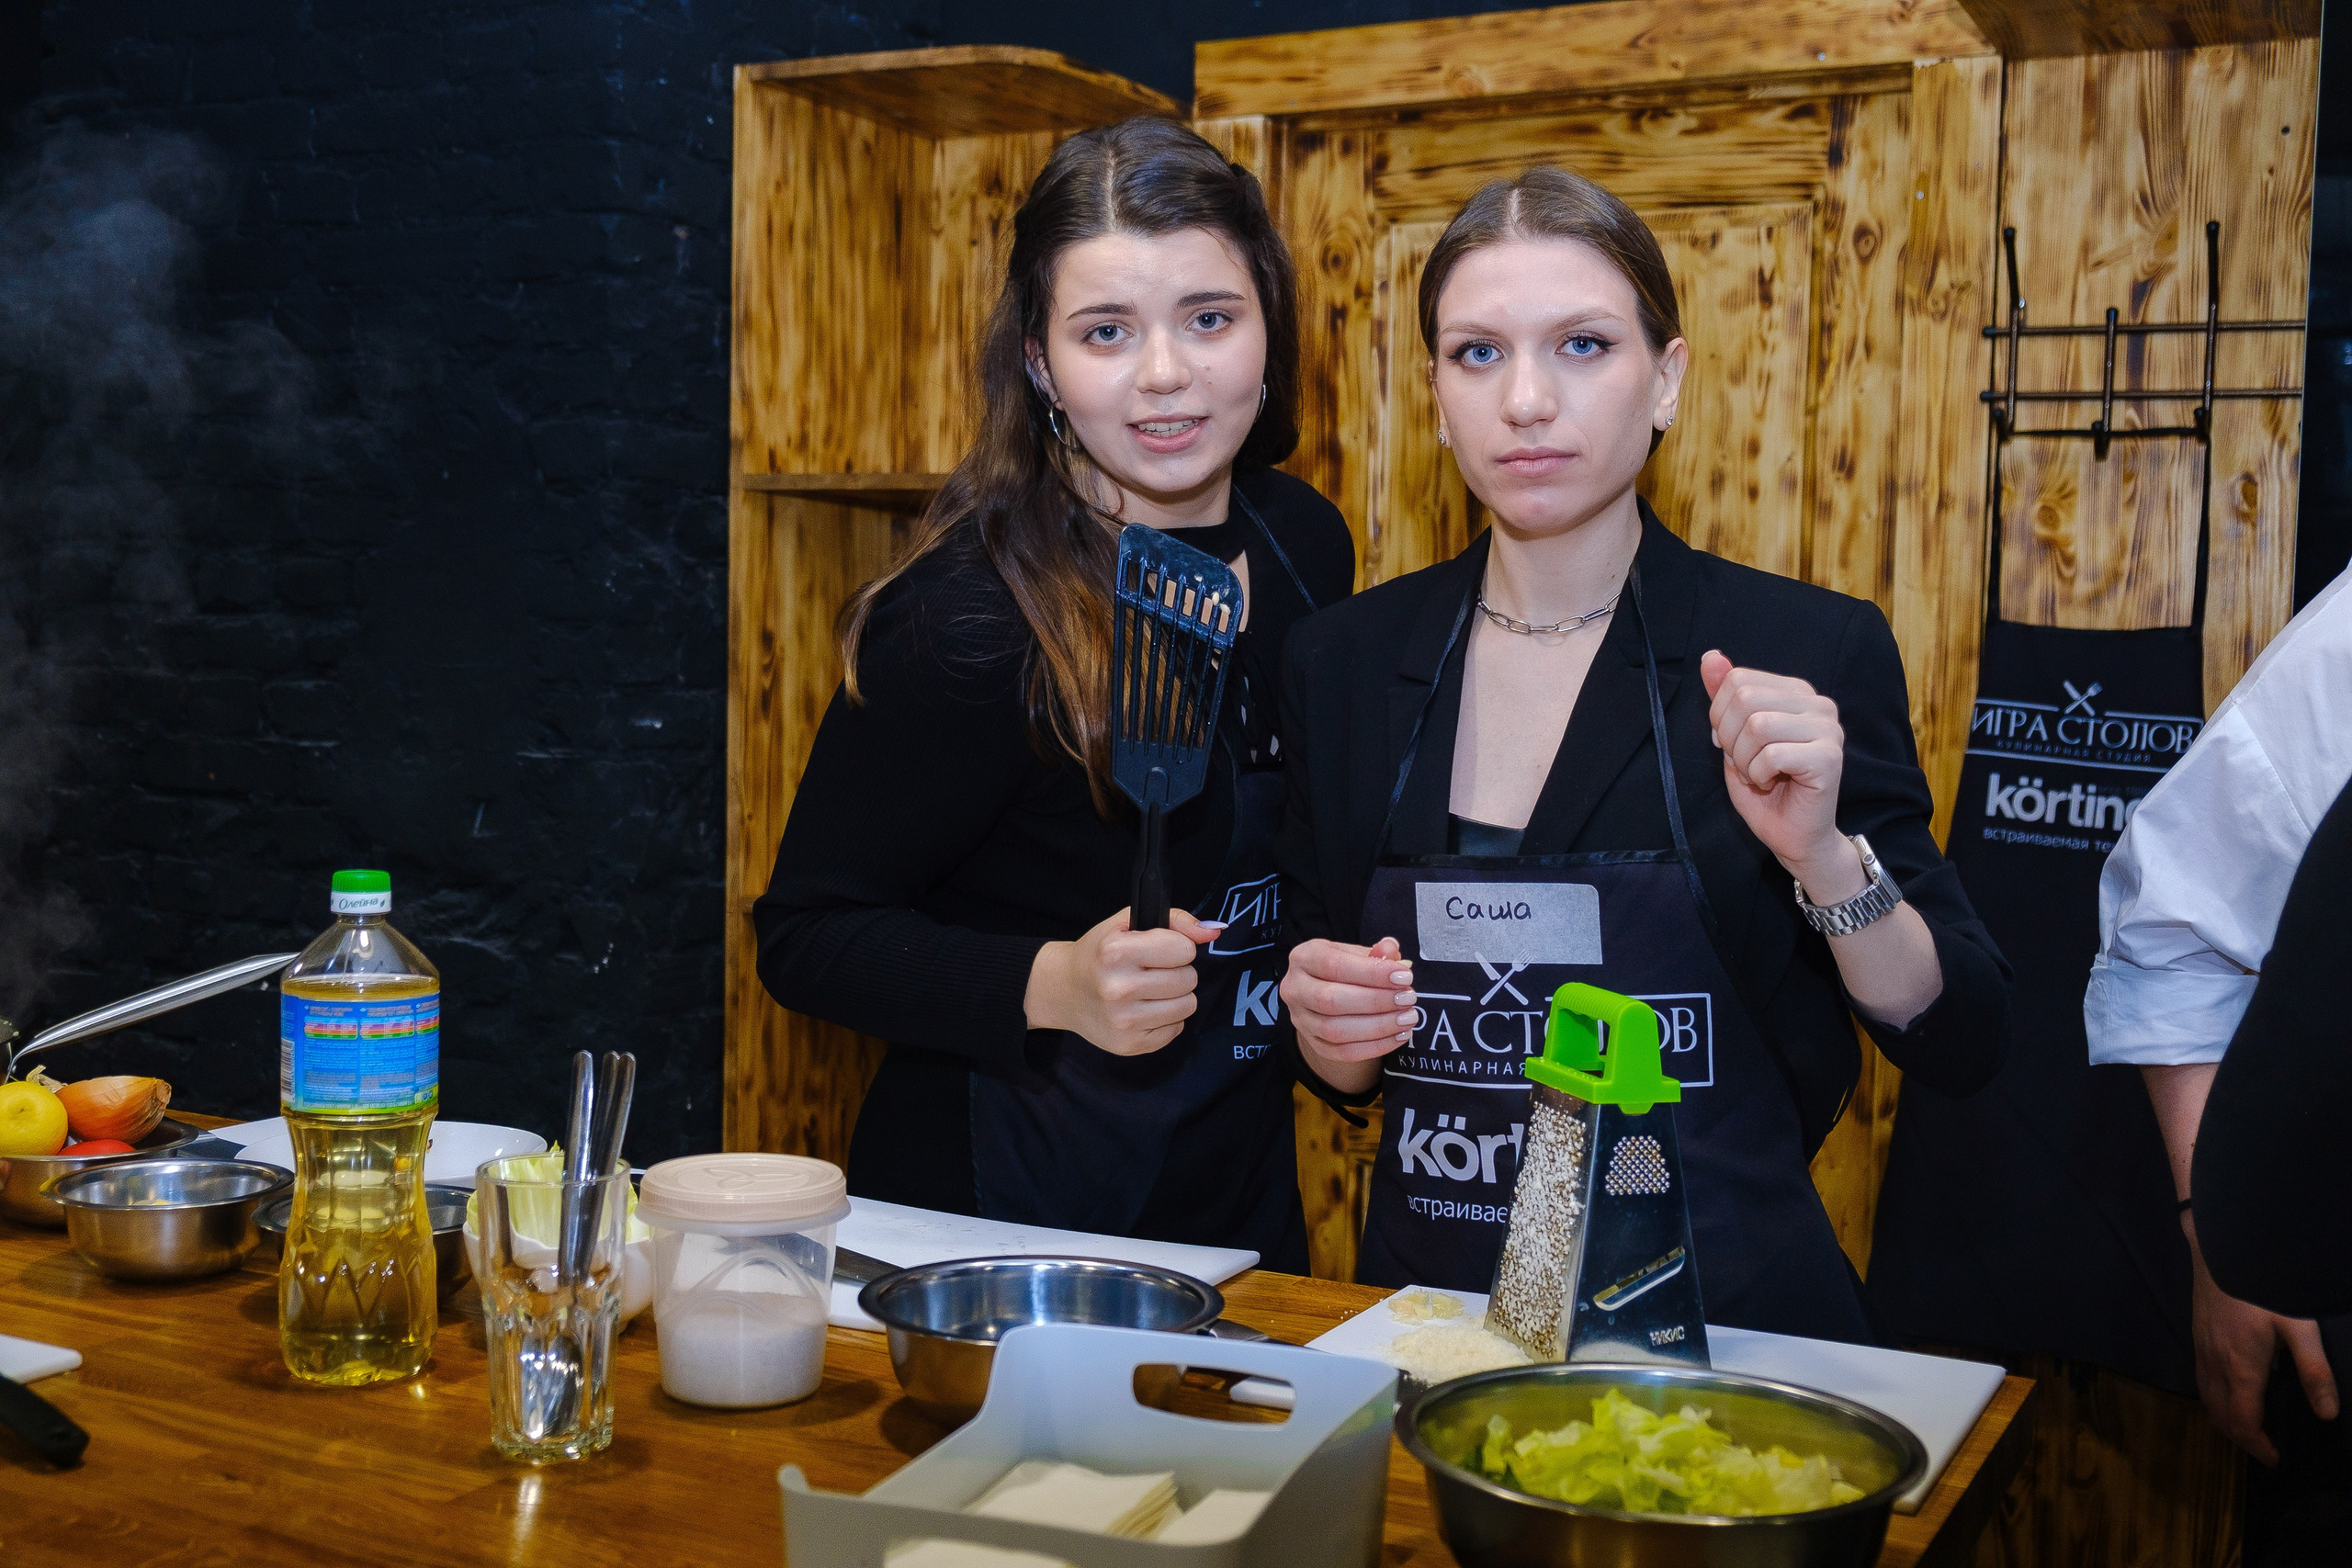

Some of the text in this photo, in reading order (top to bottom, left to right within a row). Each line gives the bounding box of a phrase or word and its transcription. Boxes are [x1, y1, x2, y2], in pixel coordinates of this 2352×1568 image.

[1972, 706, 2193, 755] ИГРА СТОЛОВ
[1995, 738, 2152, 764] КУЛИНАРНАЯ СТУДИЯ
[1983, 828, 2114, 853] встраиваемая те
[338, 897, 379, 910] Олейна
[1445, 896, 1532, 920] Саша
[1473, 1007, 1698, 1055] СТВ
[1398, 1055, 1526, 1076] КУЛИНАРНАЯ
[1407, 1194, 1509, 1224] встраивае
